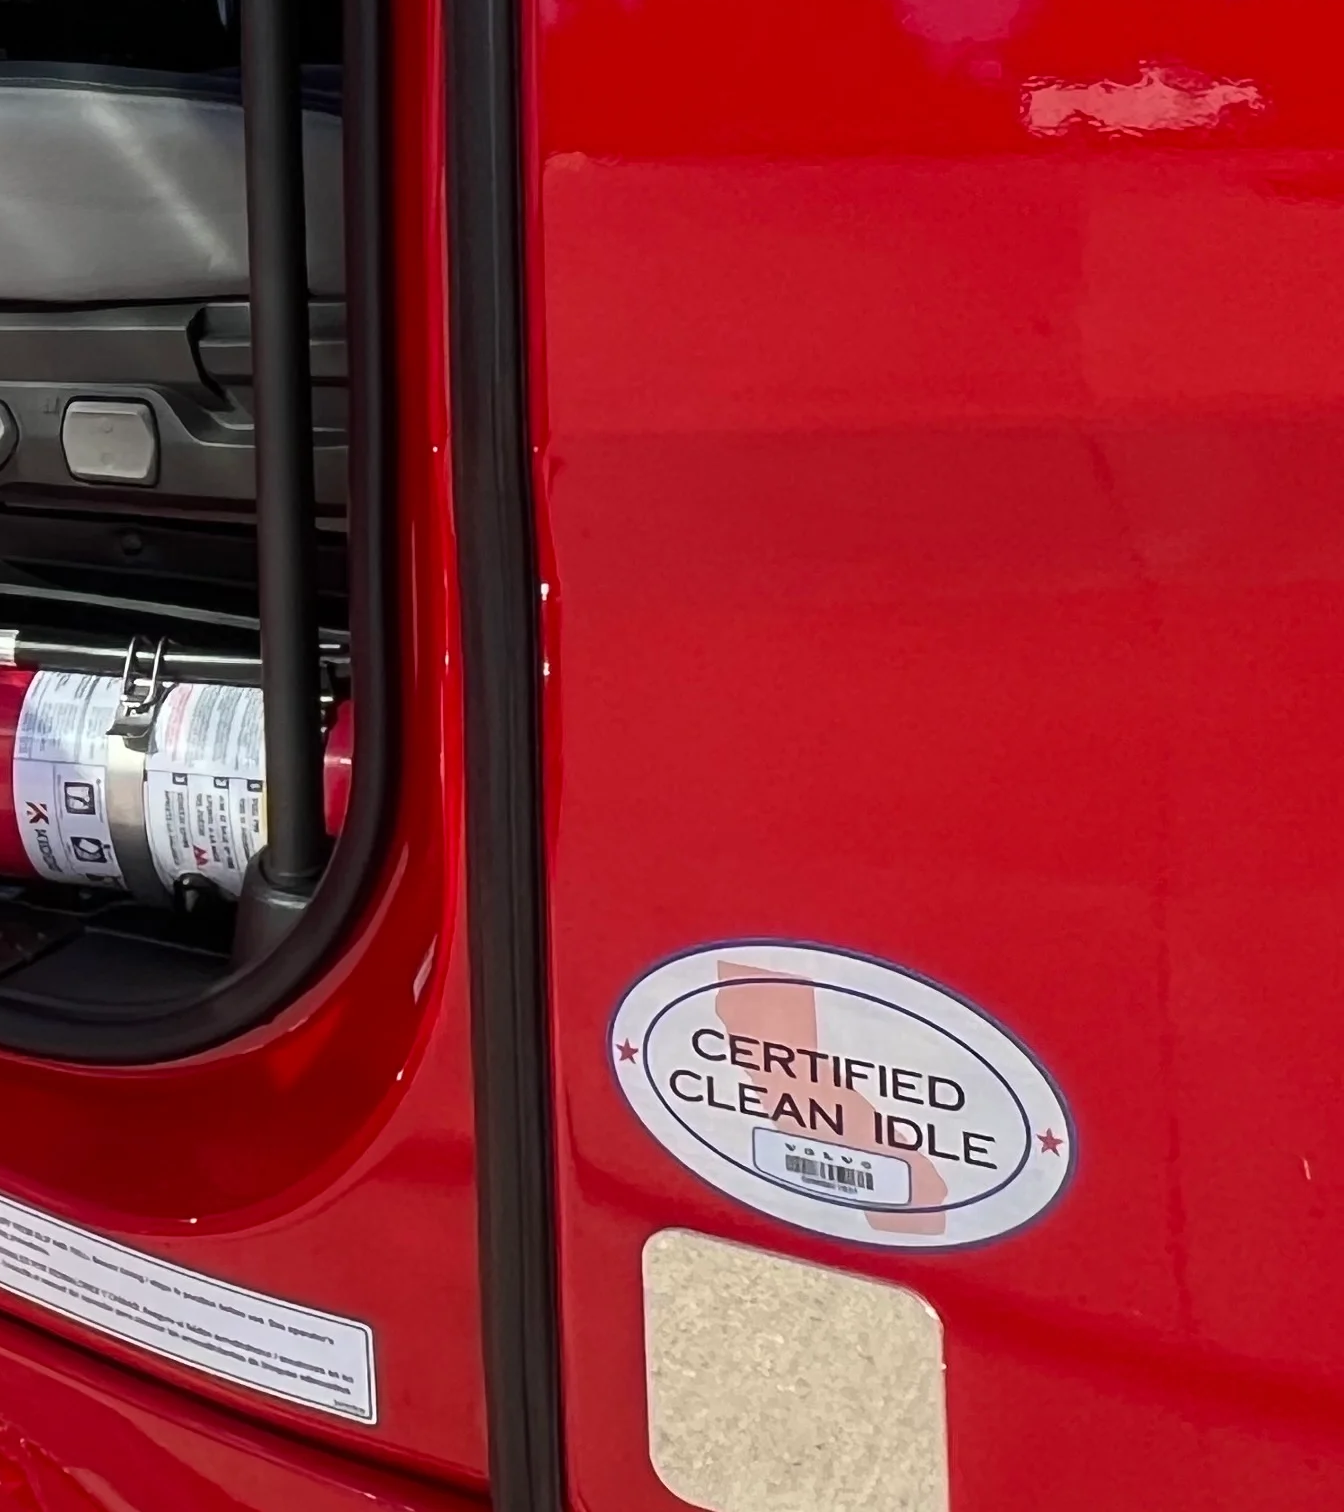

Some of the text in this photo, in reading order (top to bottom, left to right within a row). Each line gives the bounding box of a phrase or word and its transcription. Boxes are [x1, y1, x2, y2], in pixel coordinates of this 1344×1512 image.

[691, 1027, 966, 1112] CERTIFIED
[668, 1069, 998, 1170] CLEAN IDLE
